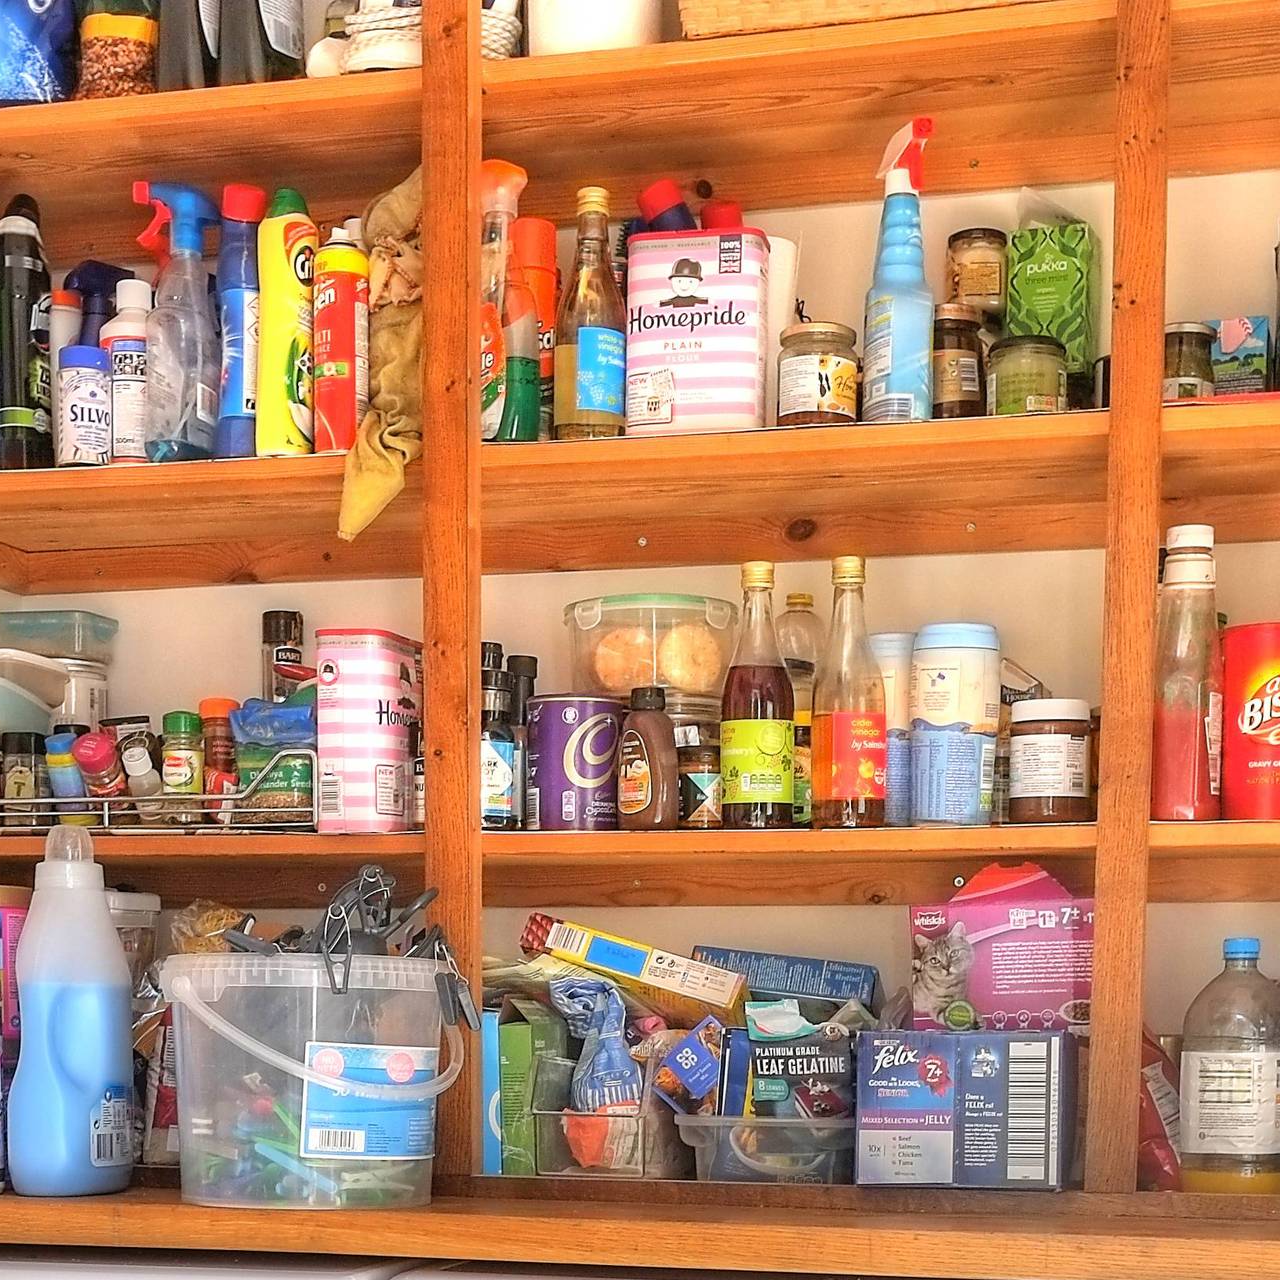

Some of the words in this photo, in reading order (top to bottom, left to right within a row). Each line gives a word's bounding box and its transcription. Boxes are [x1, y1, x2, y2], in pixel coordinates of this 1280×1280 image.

[720, 240, 741, 250] 100%
[1026, 260, 1068, 277] pukka
[629, 300, 747, 335] Homepride
[663, 340, 703, 351] PLAIN
[665, 353, 701, 363] FLOUR
[629, 376, 648, 386] NEW
[70, 404, 111, 427] SILVO
[851, 718, 873, 728] cider
[851, 740, 862, 752] by
[1248, 761, 1272, 769] GRAVY
[291, 779, 312, 789] Seed
[1061, 906, 1081, 925] 7+
[913, 915, 946, 930] whiskas
[755, 1047, 793, 1057] PLATINUM
[795, 1046, 820, 1056] GRADE
[756, 1058, 785, 1075] LEAF
[788, 1056, 846, 1075] GELATINE
[872, 1045, 920, 1075] felix
[758, 1081, 765, 1091] 8
[861, 1116, 883, 1125] MIXED
[884, 1116, 919, 1125] SELECTION
[924, 1114, 952, 1126] JELLY
[898, 1159, 914, 1167] Tuna
